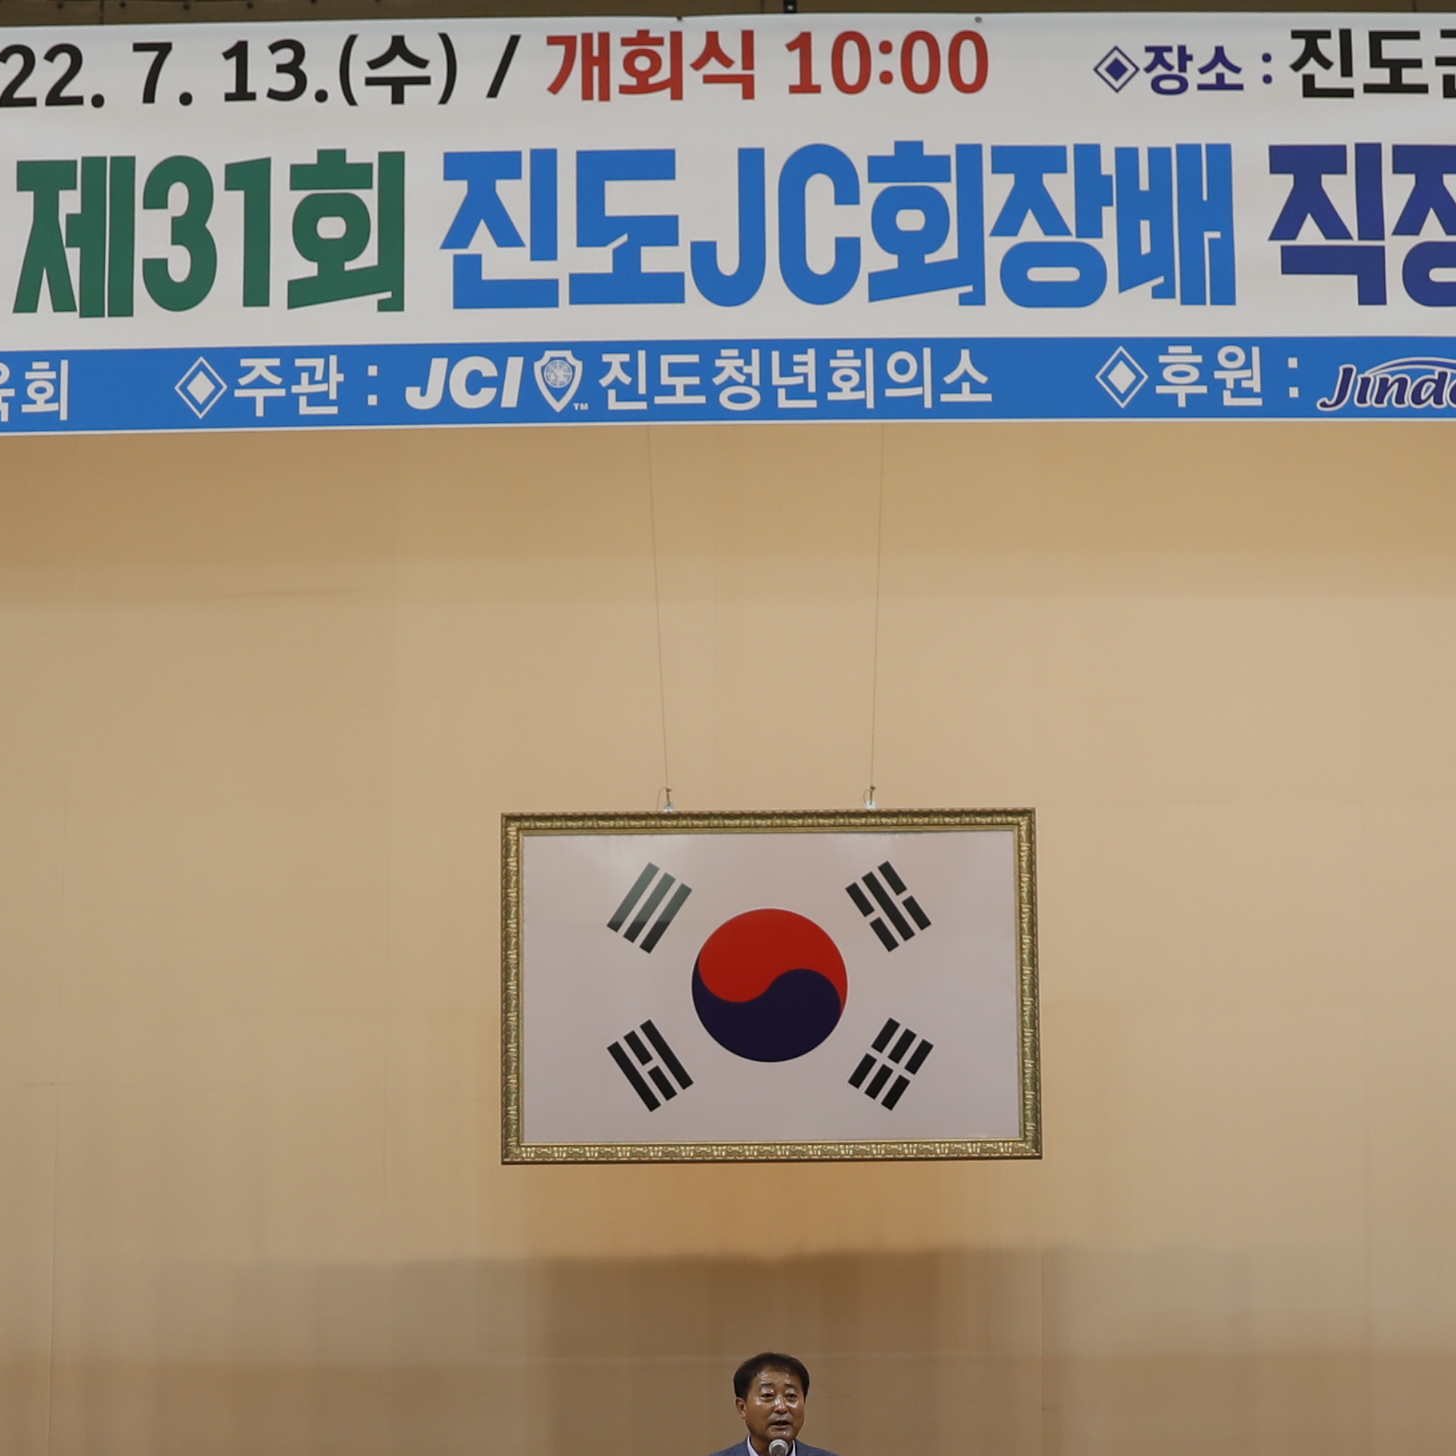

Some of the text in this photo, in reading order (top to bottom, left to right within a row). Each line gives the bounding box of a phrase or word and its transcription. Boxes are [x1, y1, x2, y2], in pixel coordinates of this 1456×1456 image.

[131, 41, 193, 107] 7.
[221, 33, 457, 107] 13.(수)
[546, 29, 756, 102] 개회식
[785, 28, 990, 97] 10:00
[1144, 44, 1245, 96] 장소
[13, 148, 405, 317] 제31회
[439, 140, 1236, 310] 진도JC회장배
[233, 355, 345, 418] 주관
[406, 355, 523, 410] JCI
[598, 346, 993, 411] 진도청년회의소
[1155, 344, 1263, 409] 후원
